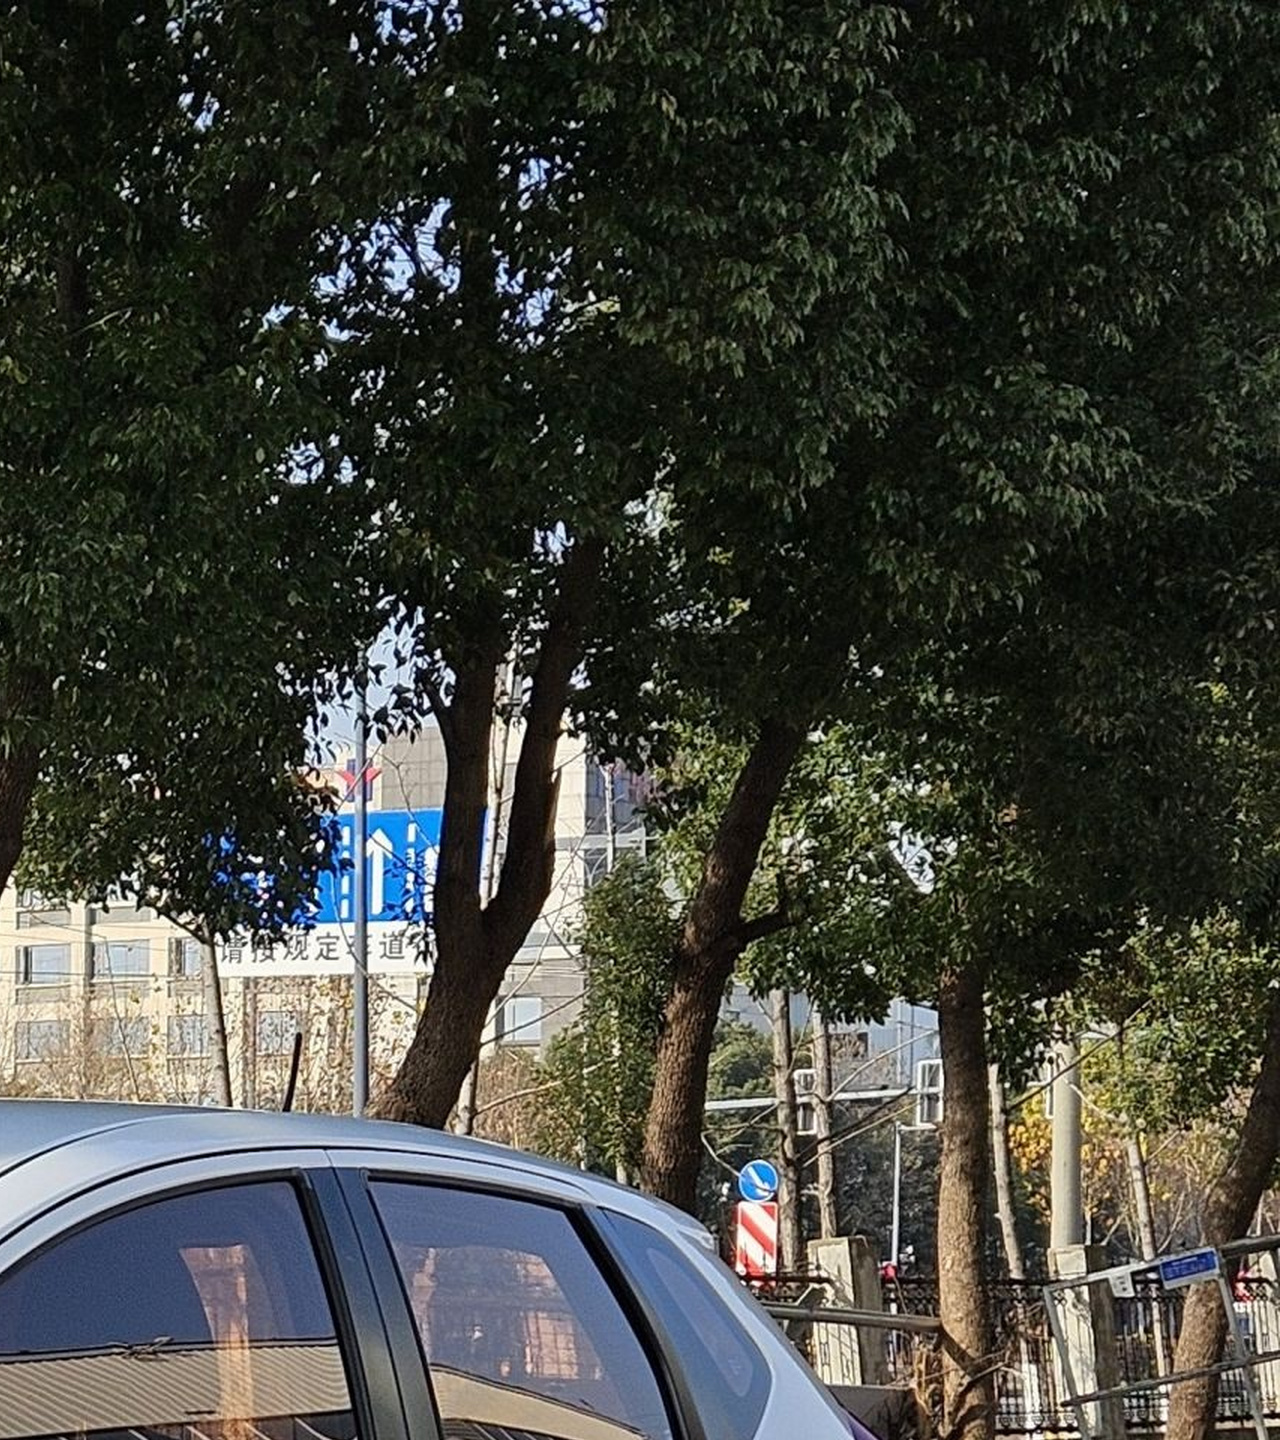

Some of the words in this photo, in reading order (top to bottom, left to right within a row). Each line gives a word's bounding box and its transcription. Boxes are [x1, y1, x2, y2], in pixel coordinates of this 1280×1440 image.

[217, 930, 434, 965] 请按规定道
